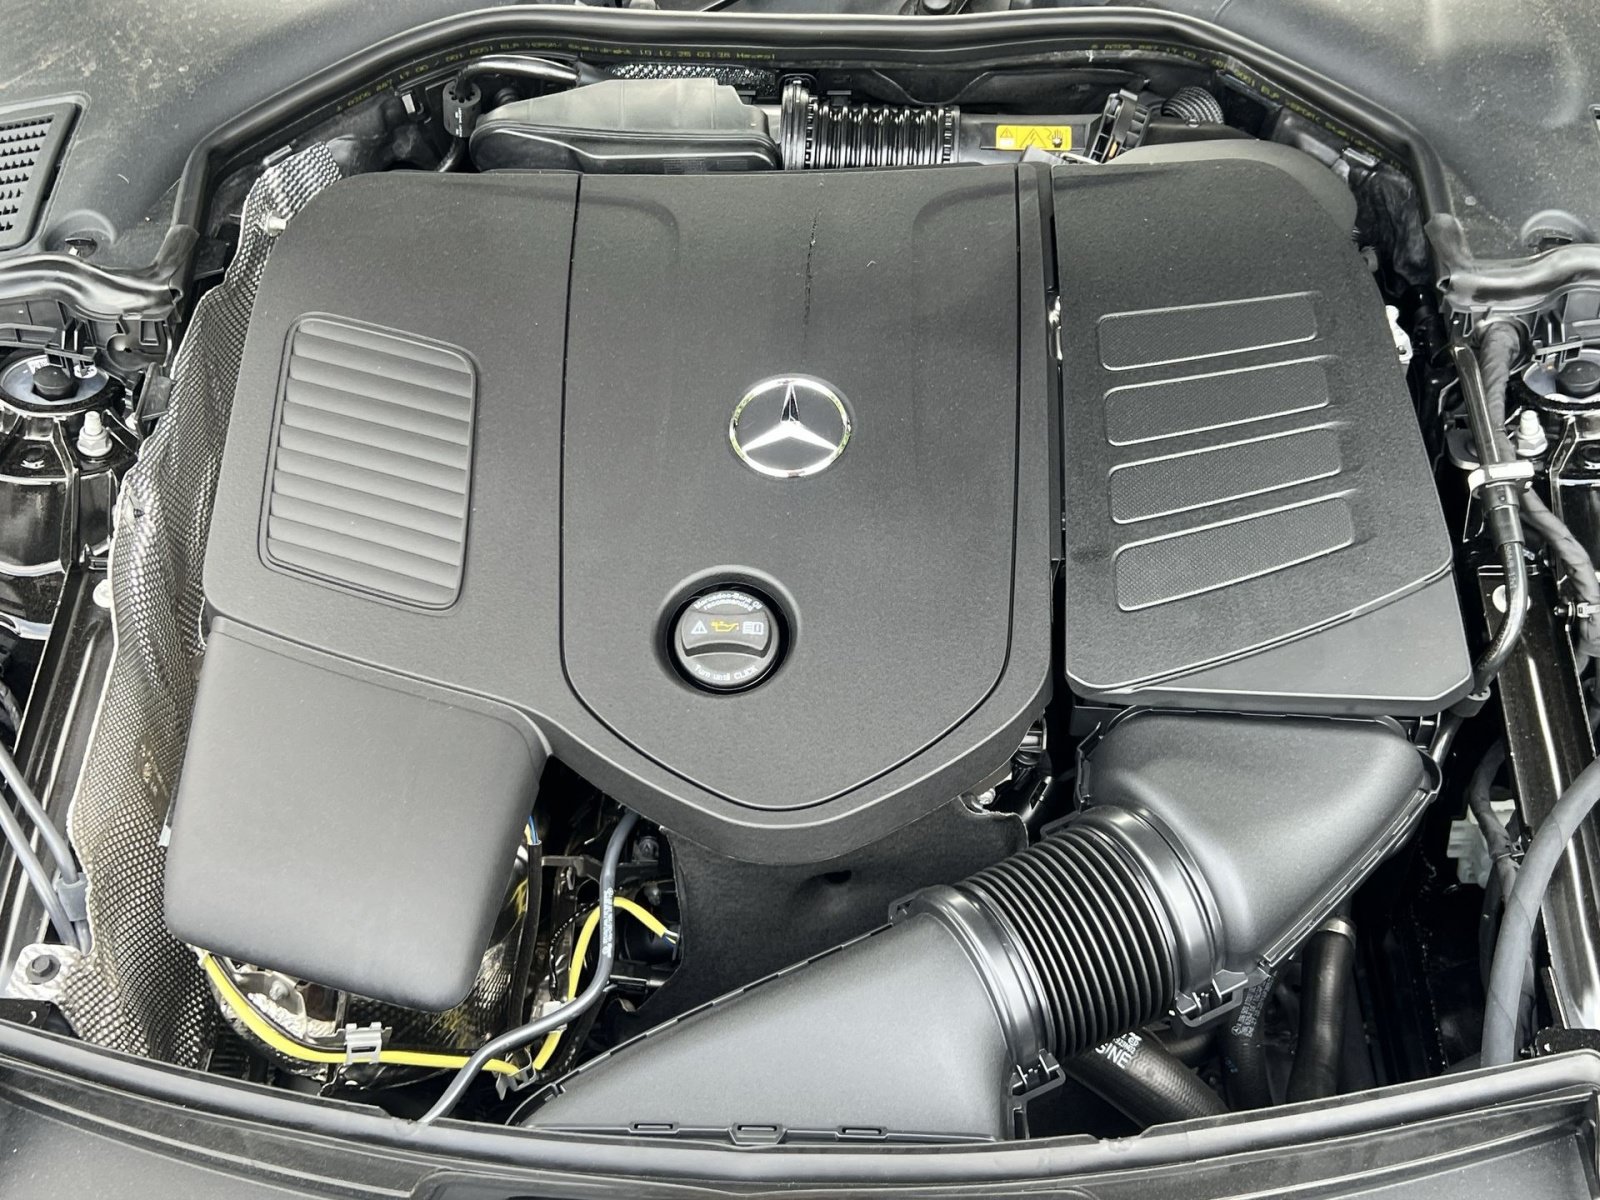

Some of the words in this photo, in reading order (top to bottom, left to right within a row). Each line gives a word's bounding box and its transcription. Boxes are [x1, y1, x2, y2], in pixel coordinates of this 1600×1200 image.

[695, 664, 711, 678] Turn
[713, 672, 731, 681] until
[734, 665, 758, 680] CLICK
